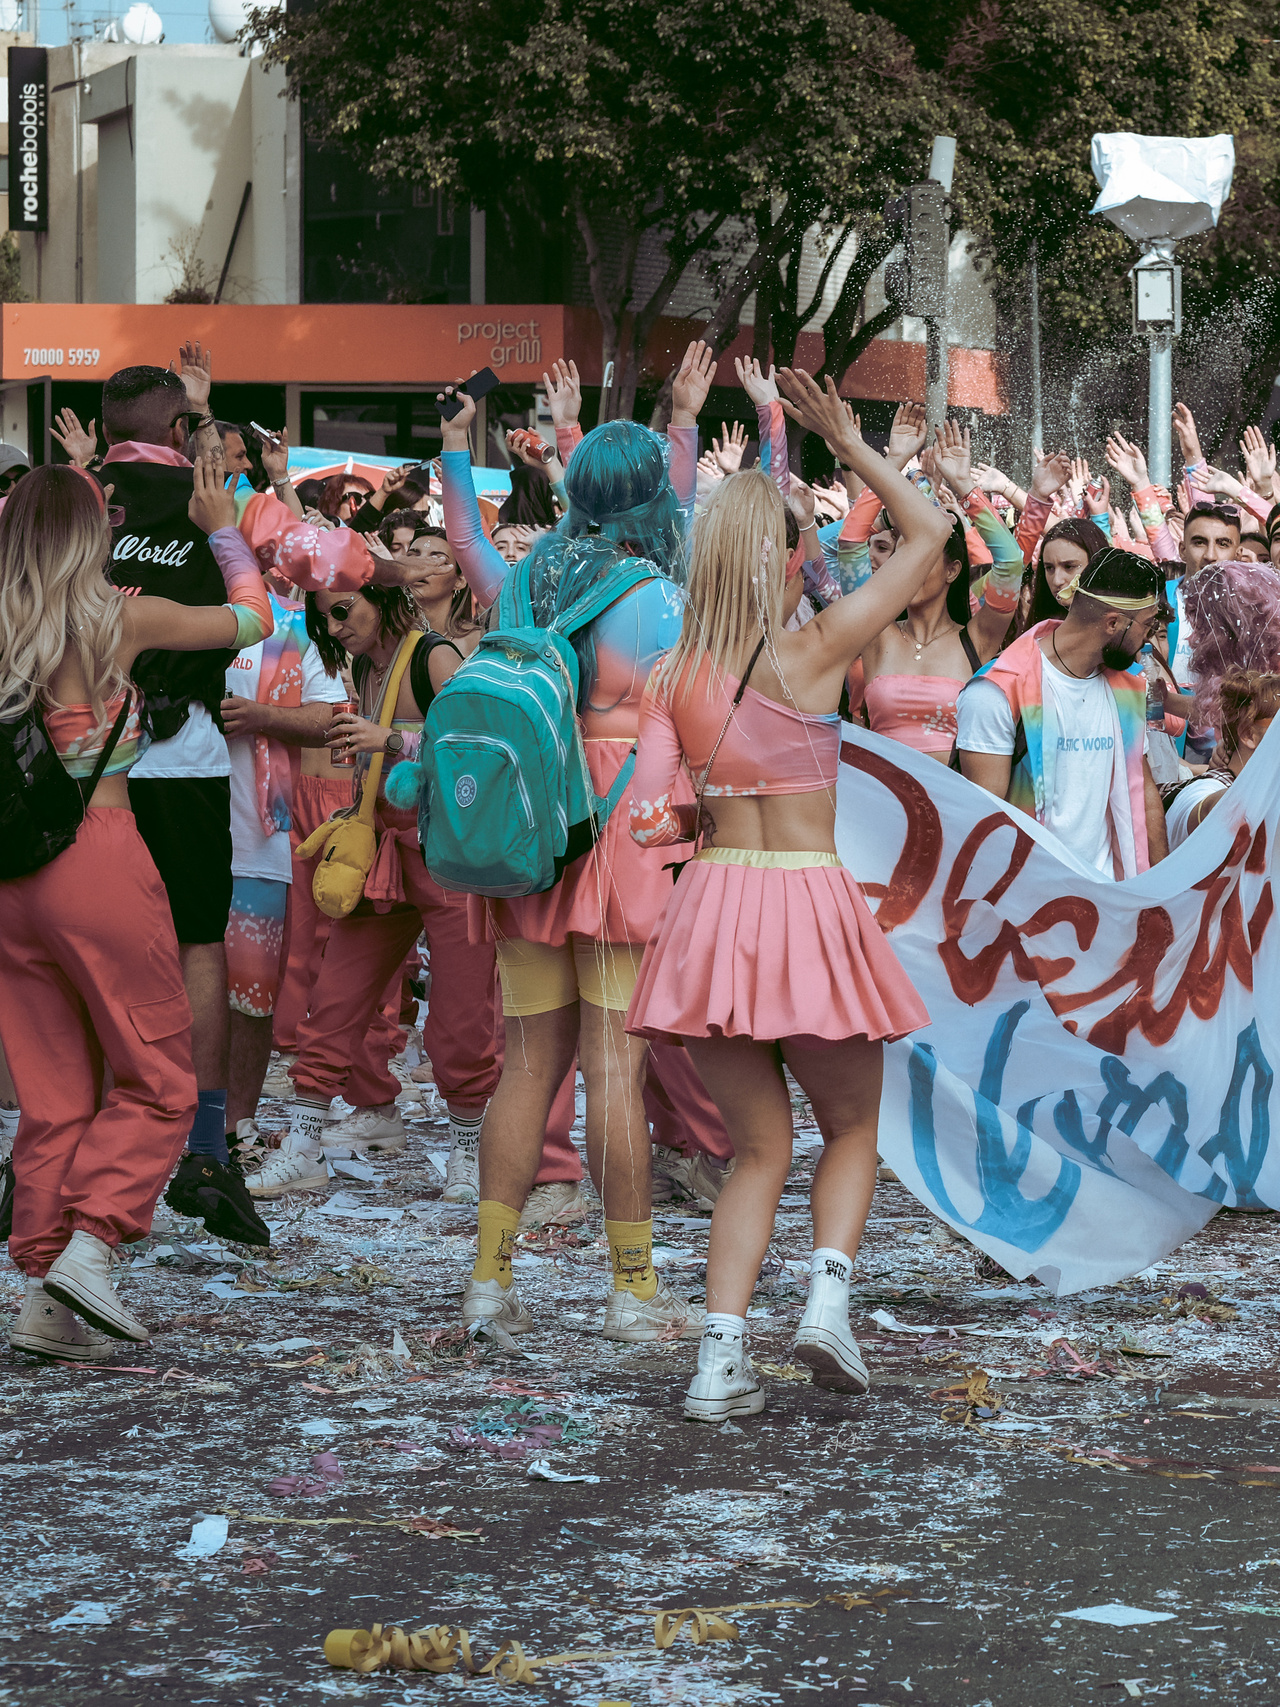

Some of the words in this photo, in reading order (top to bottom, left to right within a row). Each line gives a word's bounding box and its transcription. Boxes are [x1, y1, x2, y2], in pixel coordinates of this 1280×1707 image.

[19, 83, 38, 222] rochebobois
[458, 319, 540, 344] project
[24, 348, 64, 366] 70000
[68, 348, 100, 366] 5959
[113, 534, 194, 567] World
[300, 1122, 322, 1133] GIVE
